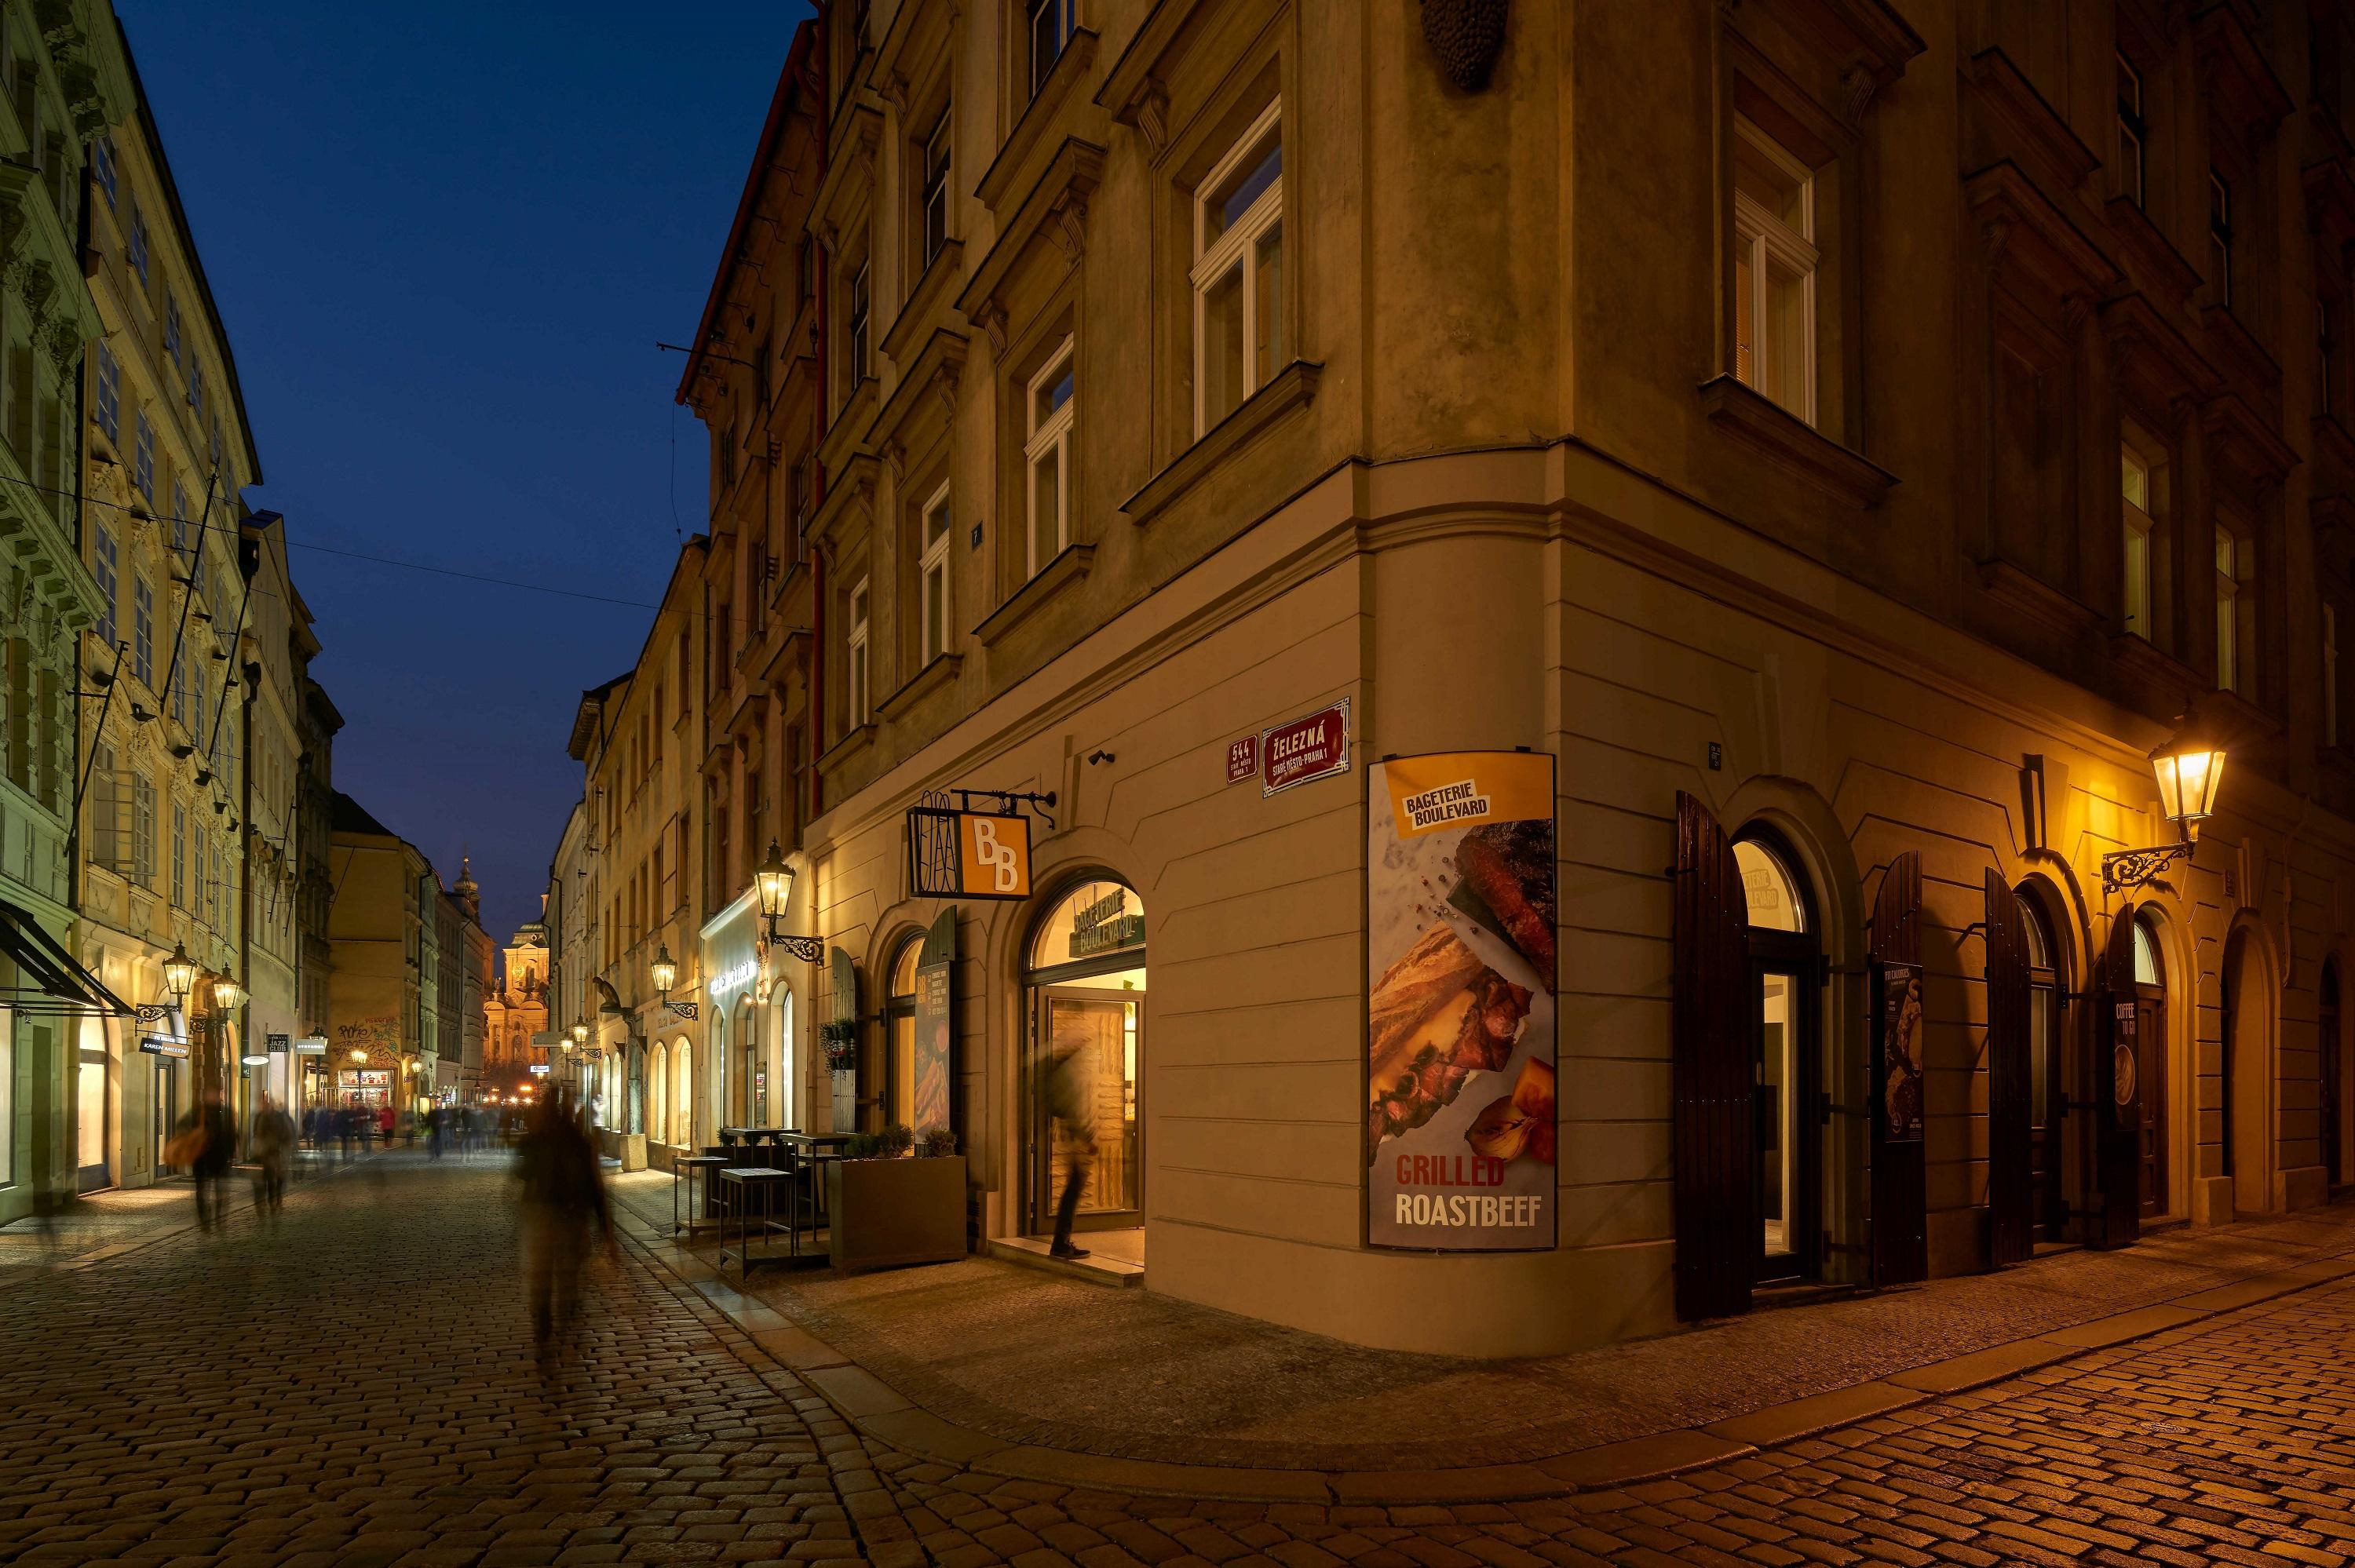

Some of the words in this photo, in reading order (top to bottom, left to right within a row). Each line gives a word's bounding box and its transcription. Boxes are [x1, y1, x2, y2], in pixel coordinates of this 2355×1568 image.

[1232, 741, 1249, 761] 544
[1273, 720, 1325, 760] ŽELEZNÁ
[1230, 761, 1239, 771] STARÉ
[1240, 758, 1251, 768] MĚSTO
[1233, 768, 1244, 777] PRAHA
[1272, 761, 1287, 776] STARÉ
[1324, 747, 1327, 759] 1
[1406, 782, 1473, 814] BAGETERIE
[1415, 799, 1488, 826] BOULEVARD
[1074, 889, 1123, 935] BAGETERIE
[1080, 916, 1133, 953] BOULEVARD
[2116, 1003, 2134, 1019] COFFEE
[2122, 1020, 2128, 1035] TO
[2129, 1020, 2136, 1035] GO
[1397, 1154, 1504, 1187] GRILLED
[1396, 1194, 1542, 1227] ROASTBEEF
